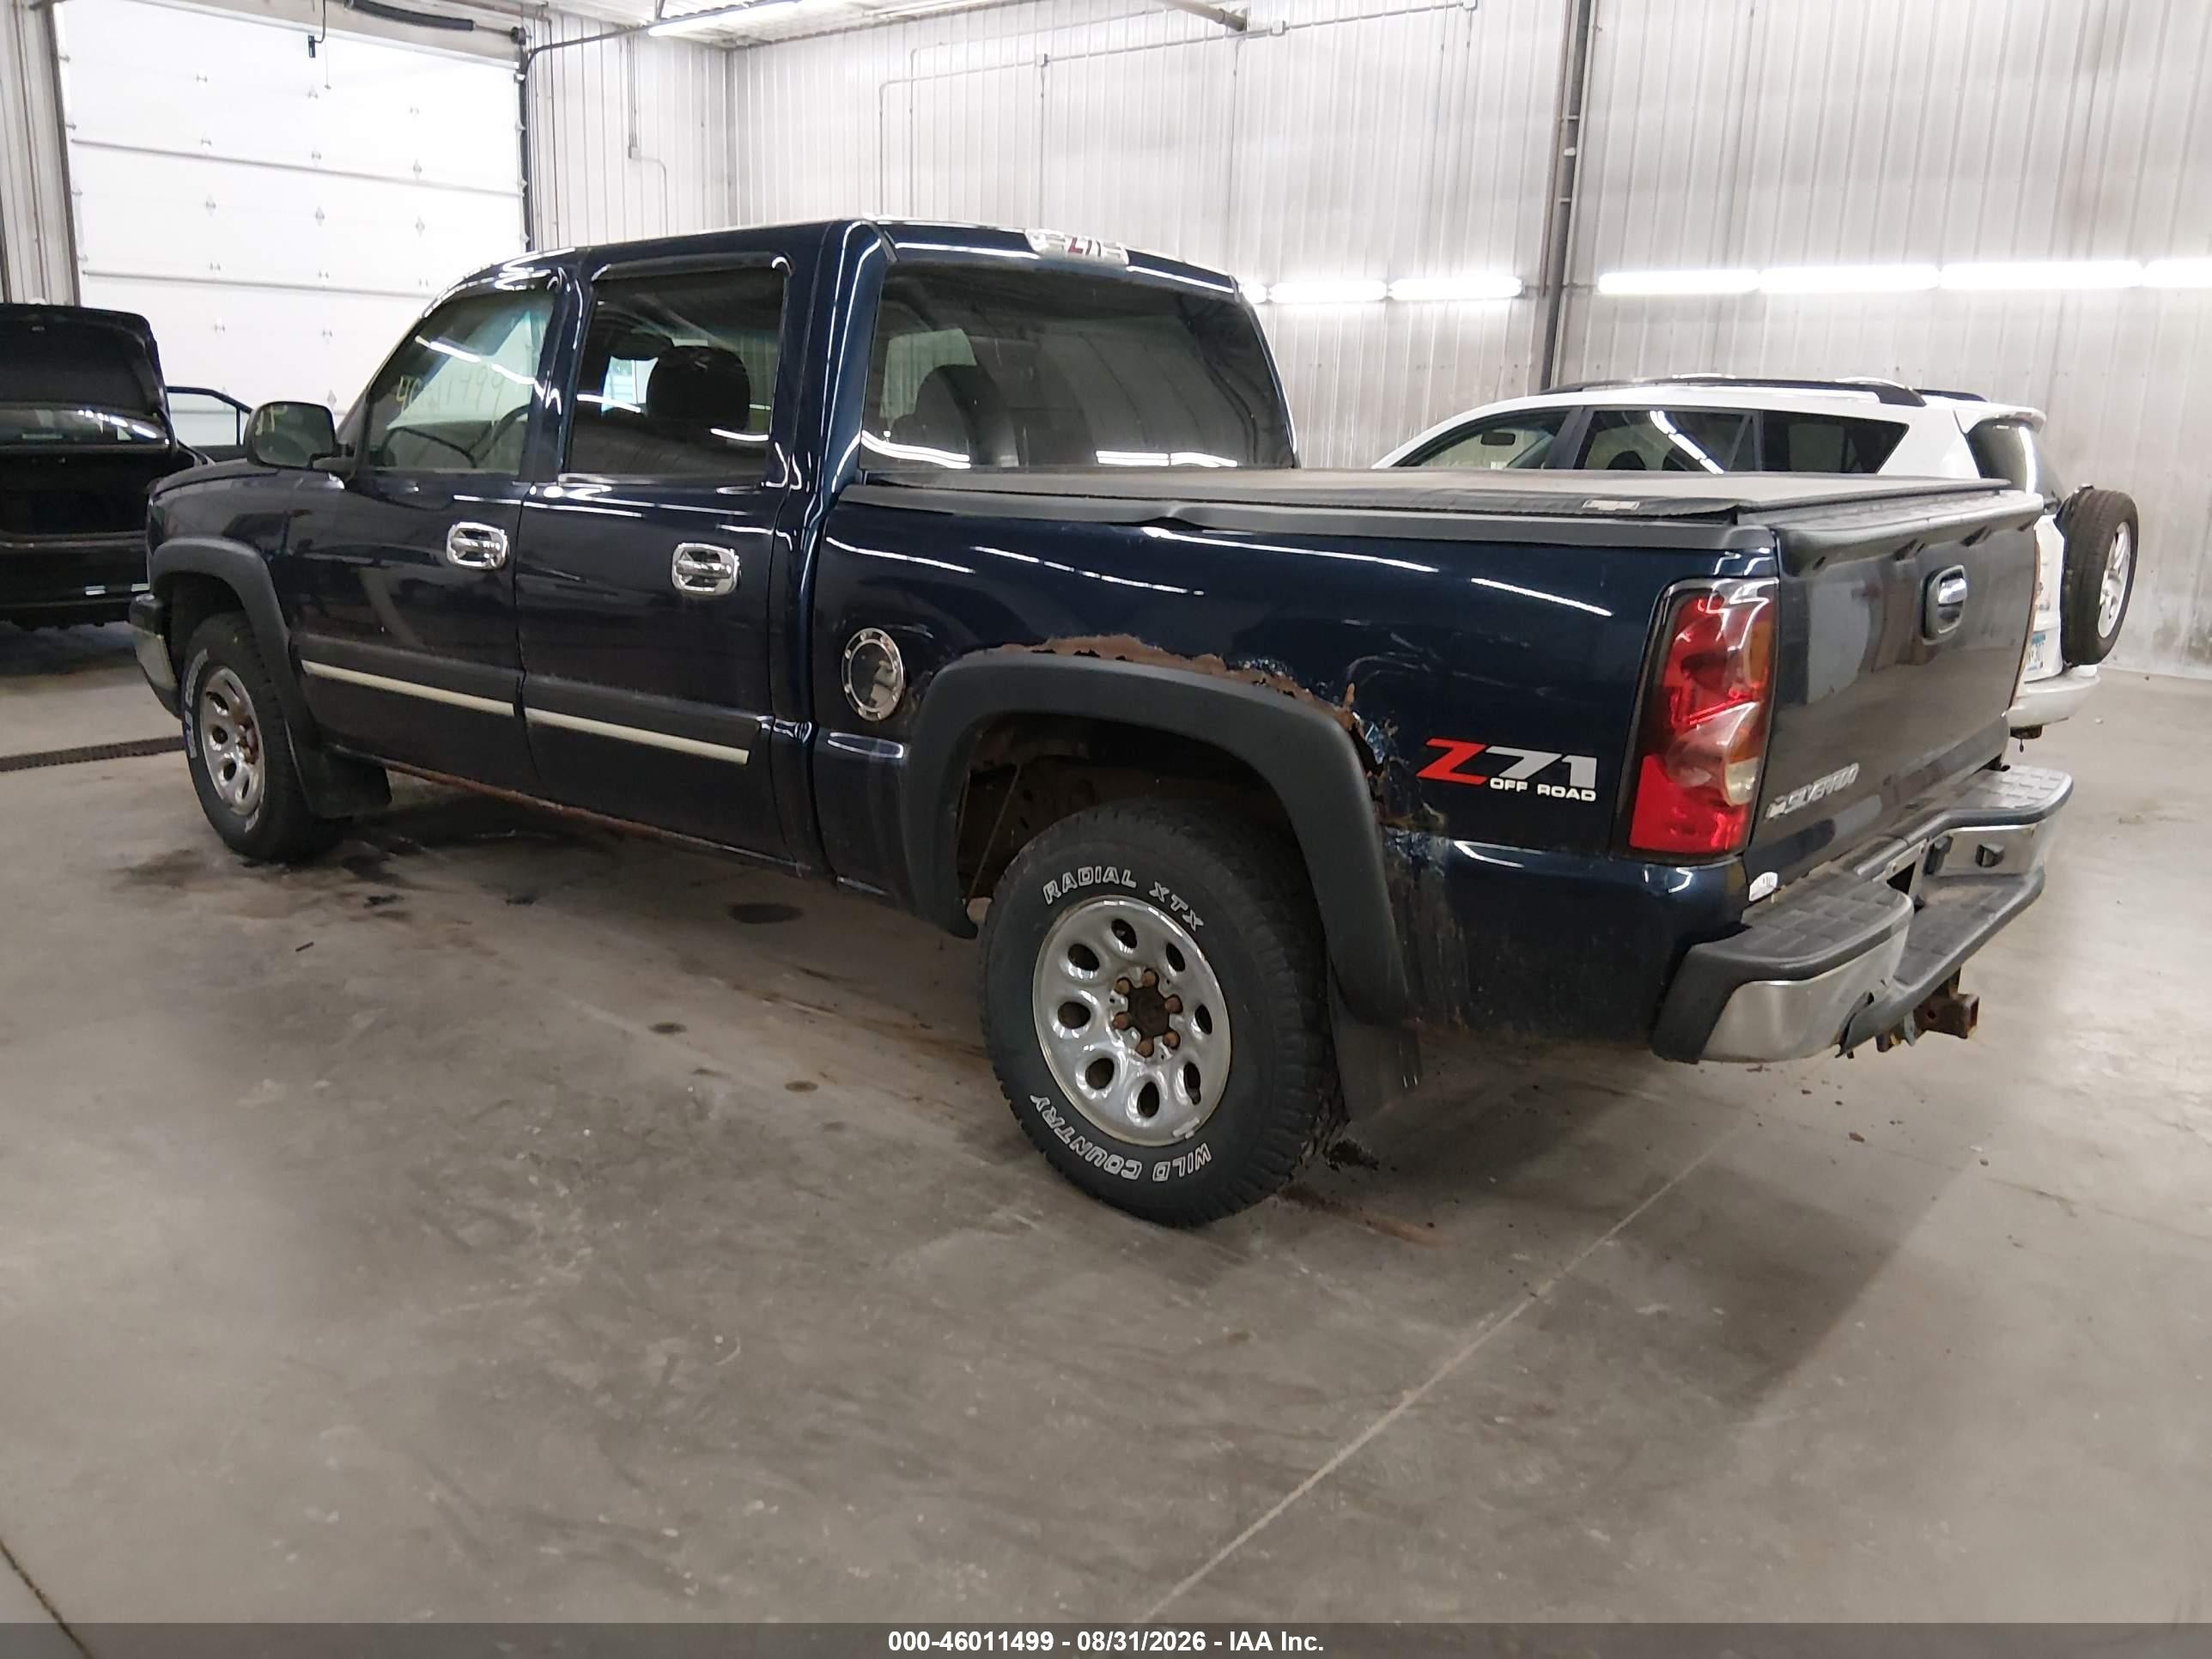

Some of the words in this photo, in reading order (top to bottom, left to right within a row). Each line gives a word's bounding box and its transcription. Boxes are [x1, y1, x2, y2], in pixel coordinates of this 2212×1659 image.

[1417, 738, 1597, 789] Z71
[1490, 777, 1528, 793] OFF
[1537, 783, 1596, 802] ROAD
[1042, 866, 1137, 905] RADIAL
[1149, 882, 1204, 932] XTX
[1030, 1095, 1143, 1180] COUNTRY
[1152, 1143, 1212, 1182] WILD
